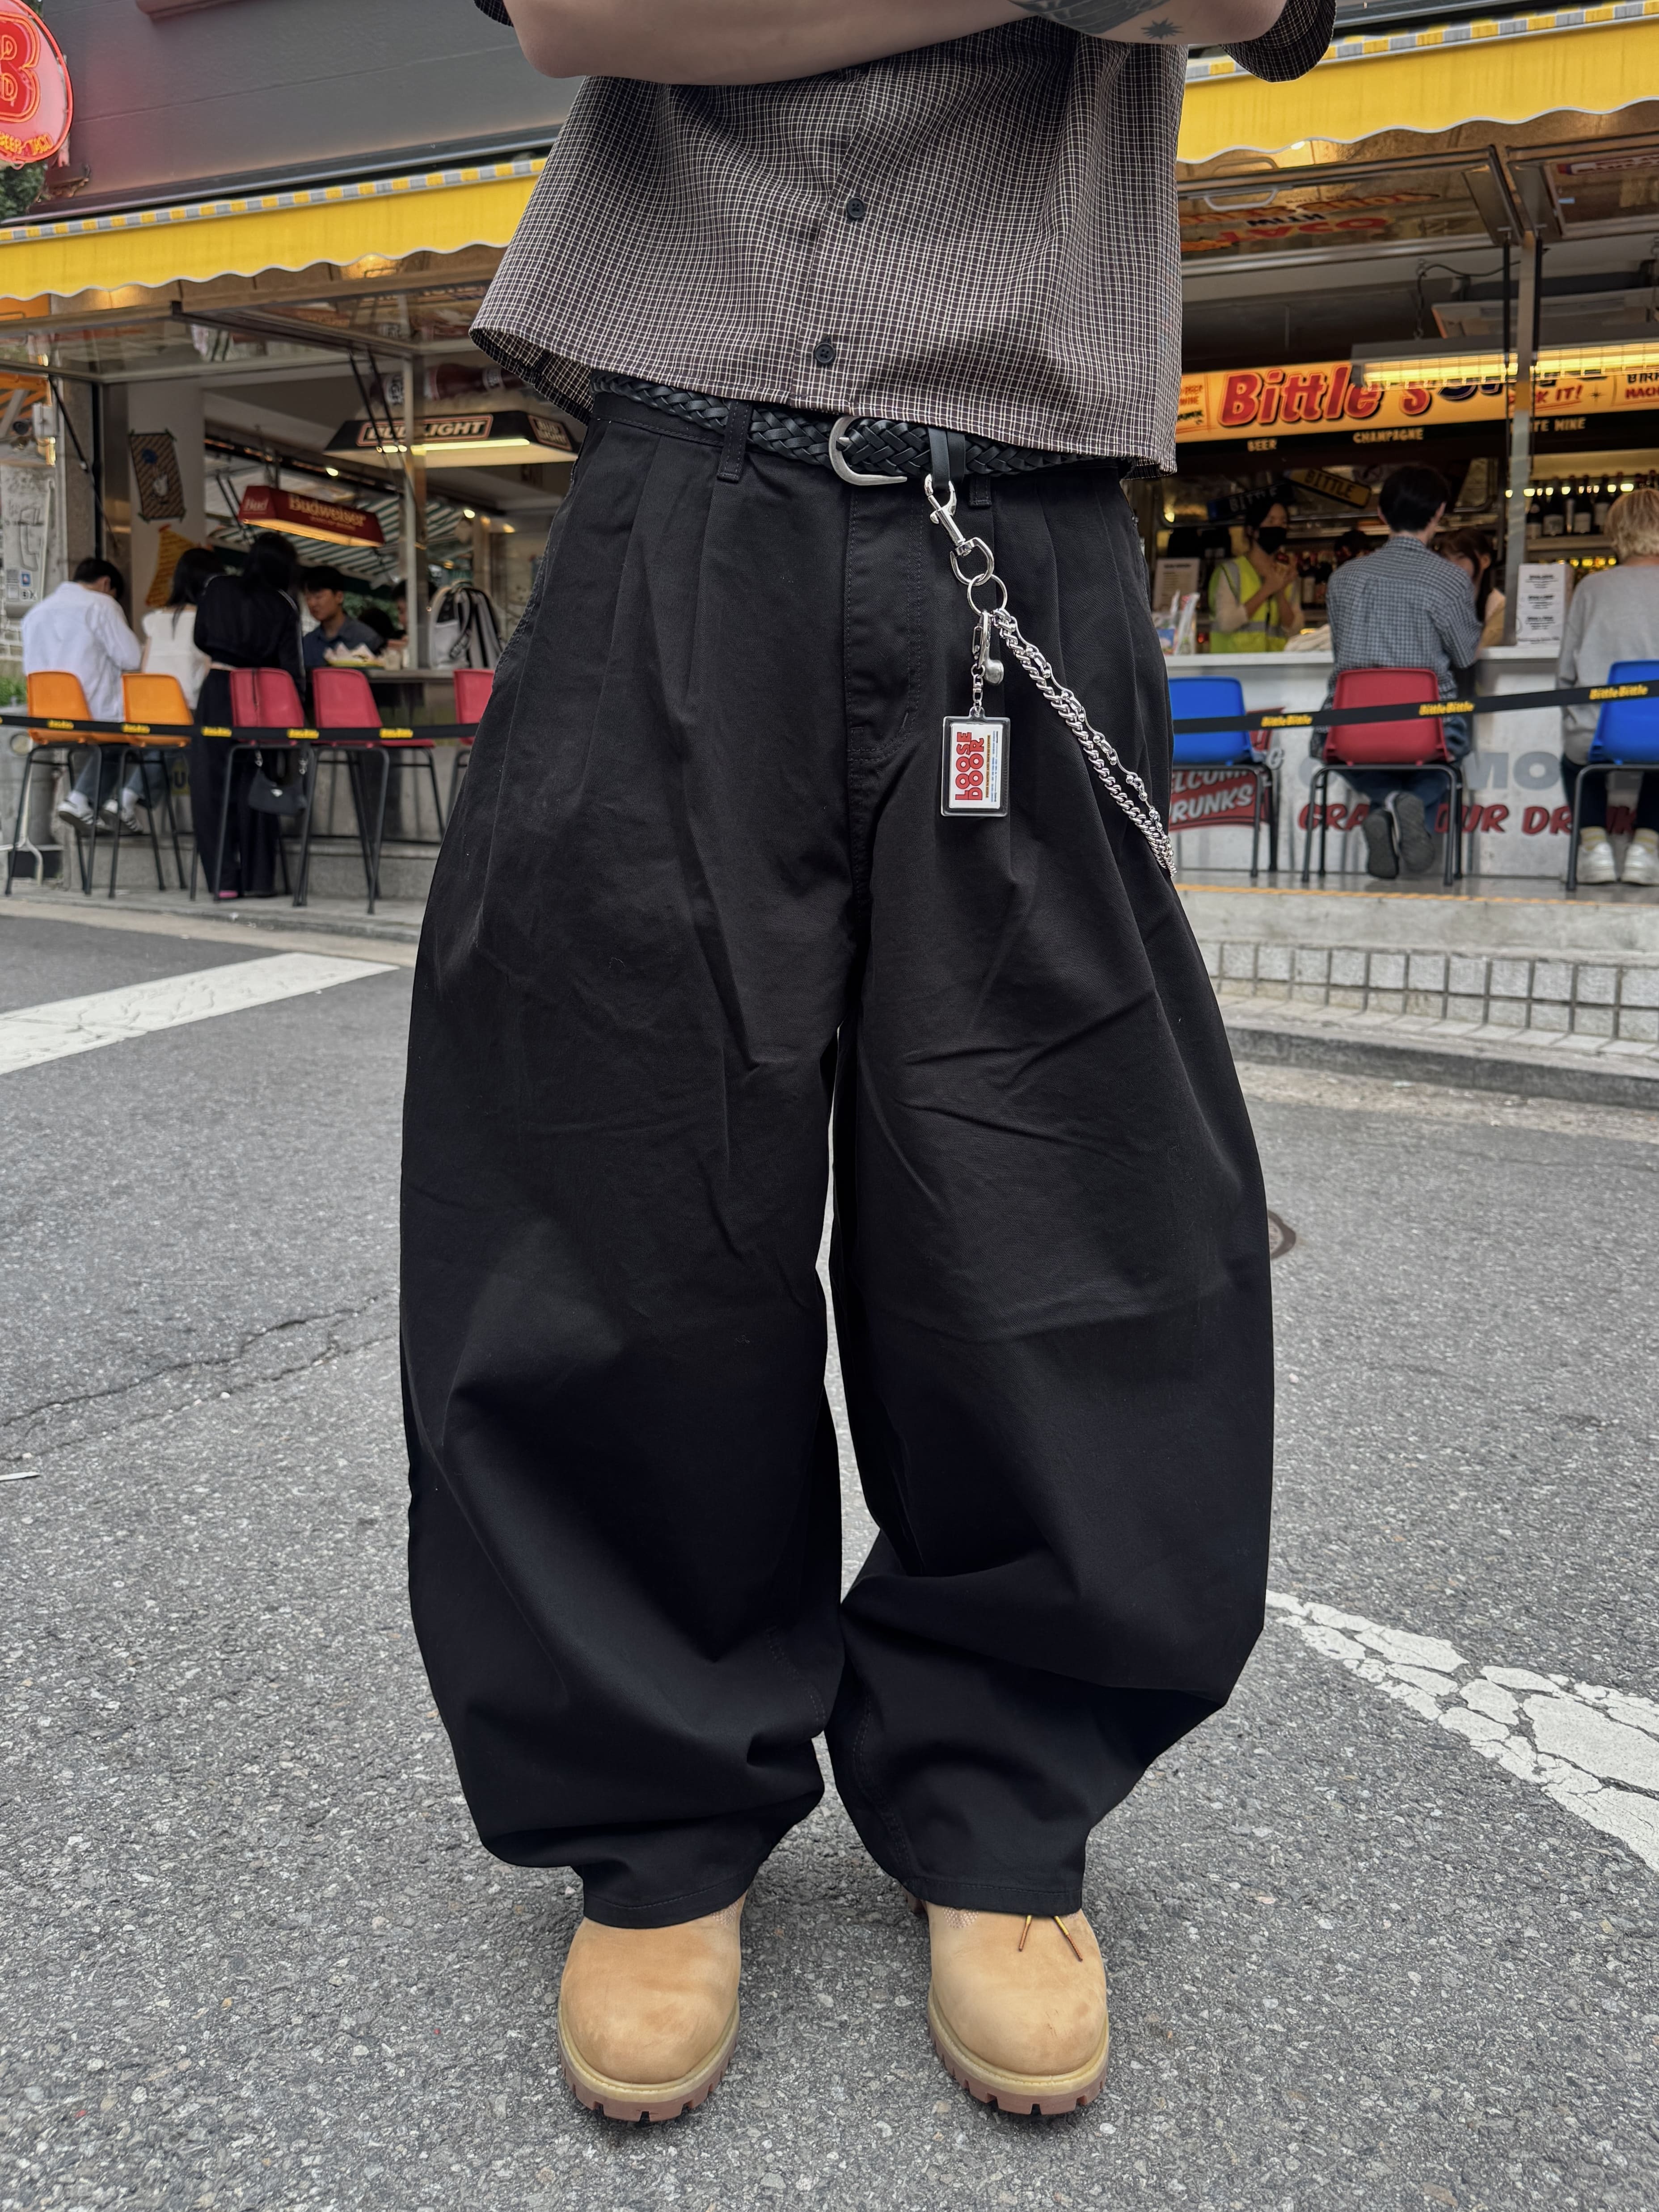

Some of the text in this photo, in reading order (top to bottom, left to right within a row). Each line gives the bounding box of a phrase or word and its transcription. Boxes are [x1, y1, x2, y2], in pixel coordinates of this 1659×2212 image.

[1247, 439, 1277, 452] BEER
[1353, 428, 1425, 443] CHAMPAGNE
[288, 493, 367, 528] Budweiser
[955, 732, 972, 800] LOOSE
[968, 738, 984, 800] DOOR
[1168, 784, 1254, 823] RUNKS
